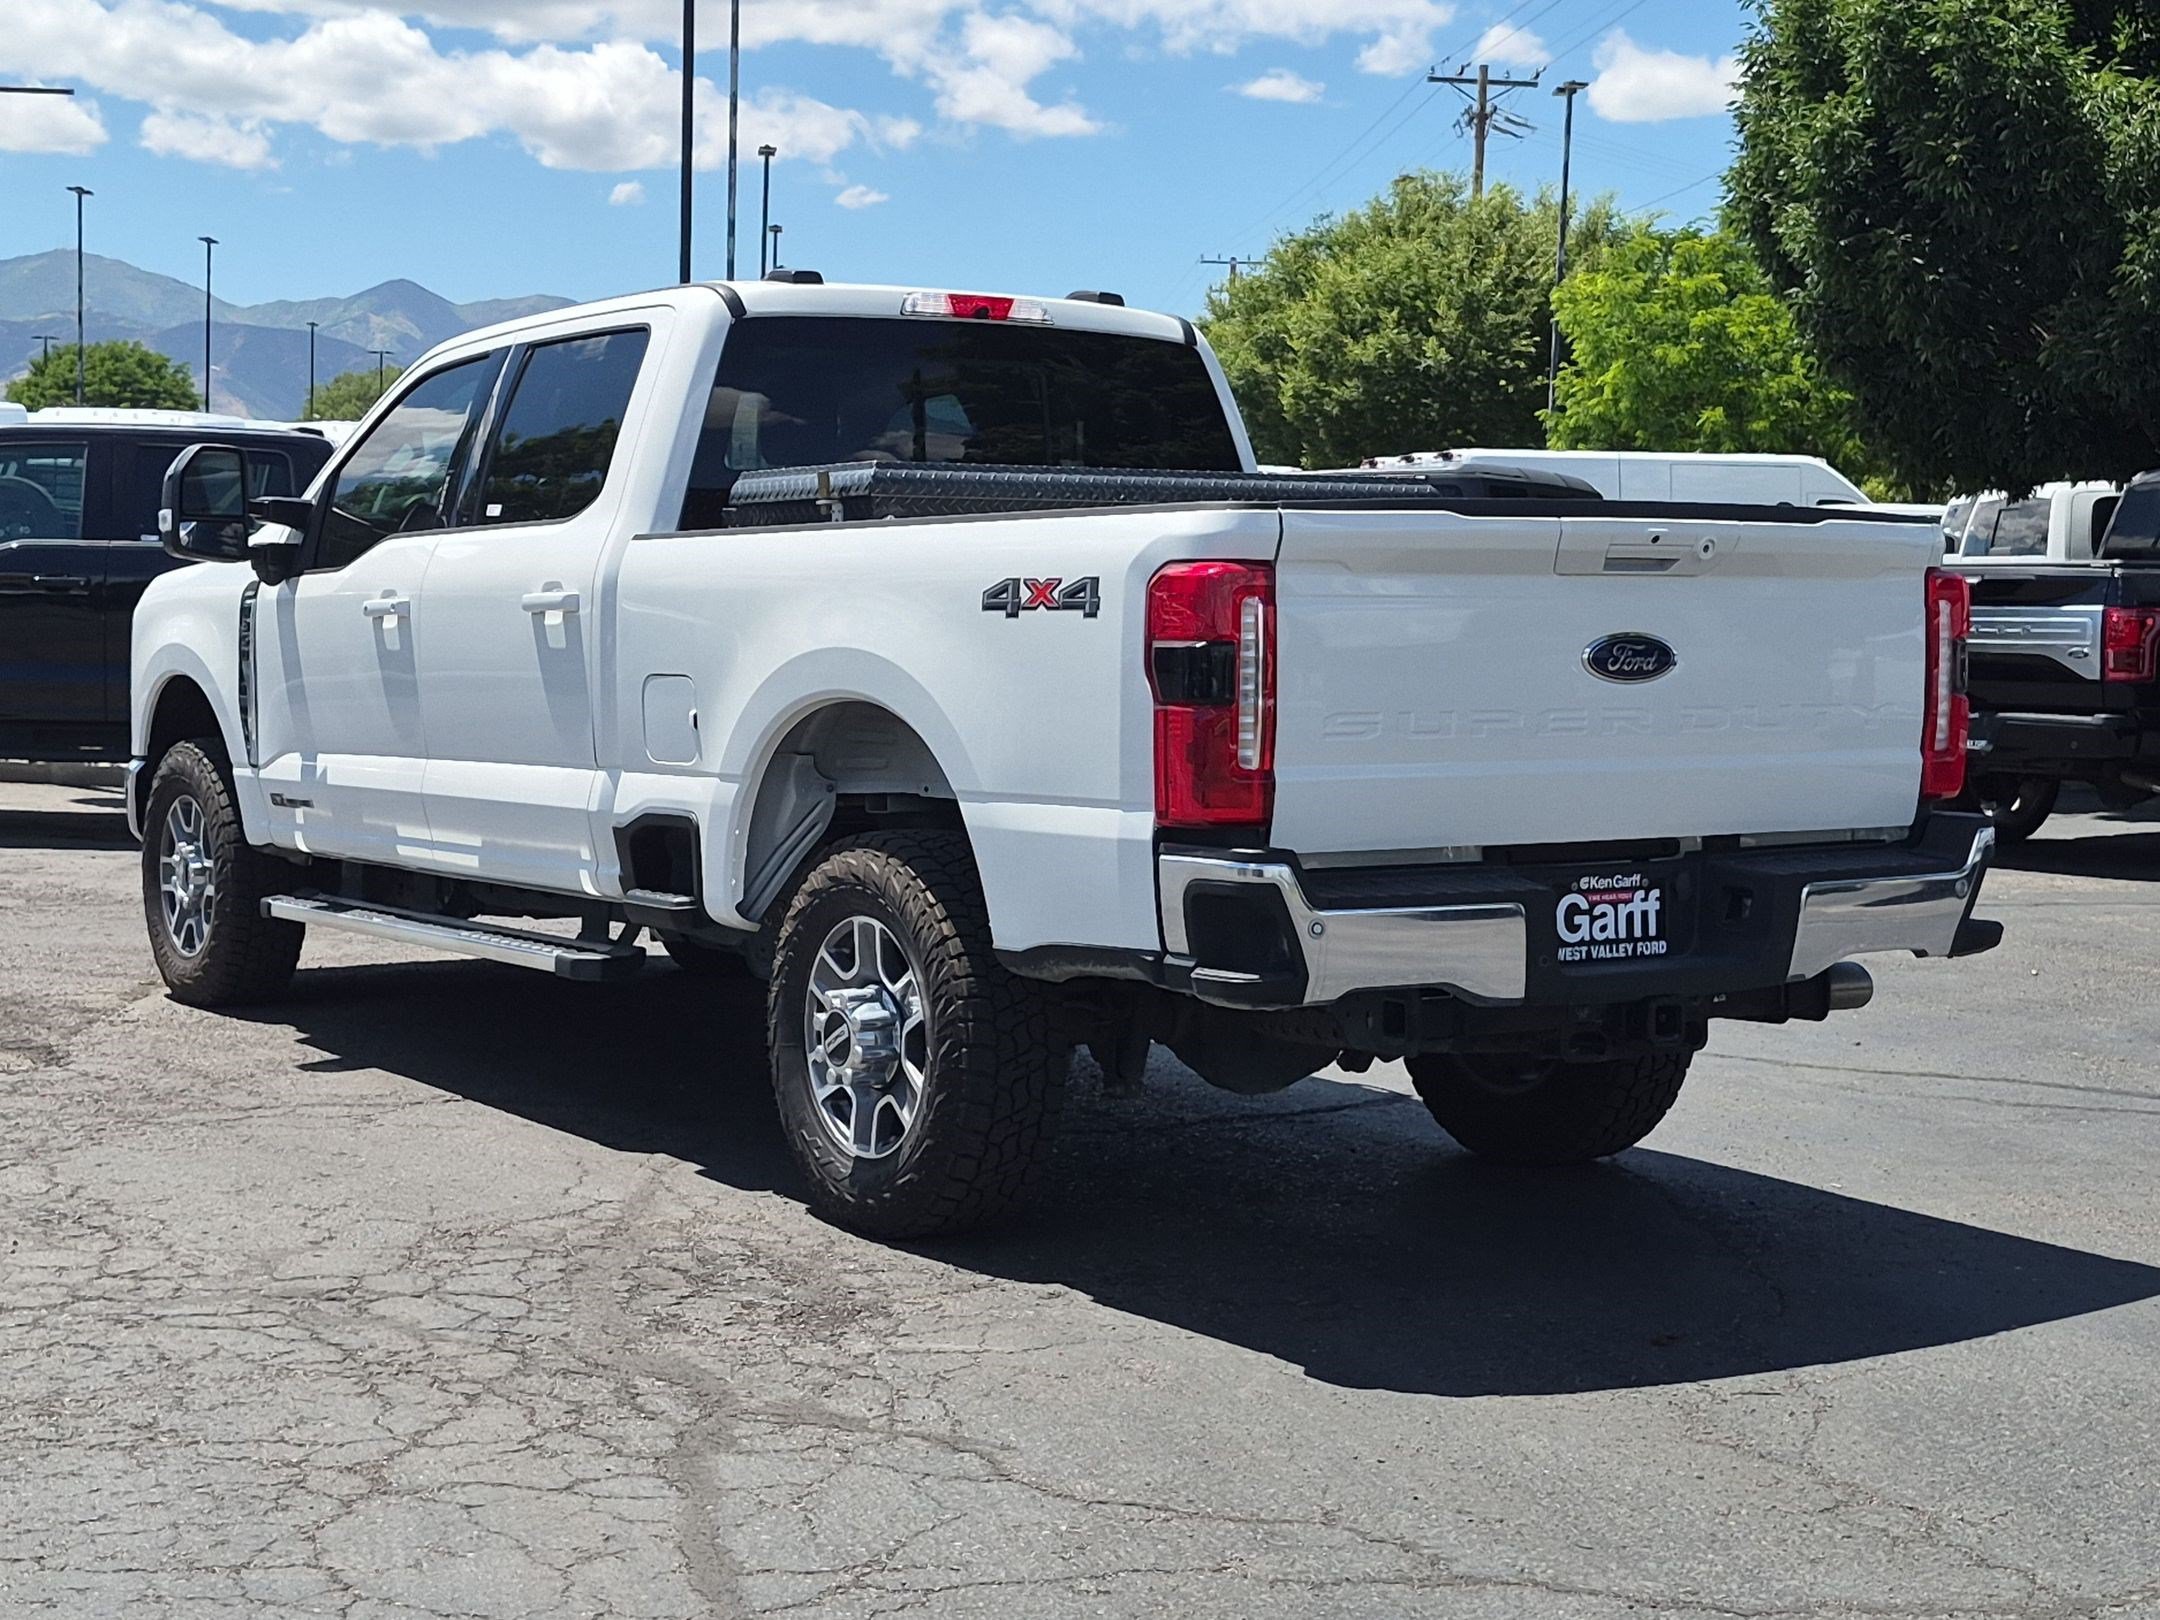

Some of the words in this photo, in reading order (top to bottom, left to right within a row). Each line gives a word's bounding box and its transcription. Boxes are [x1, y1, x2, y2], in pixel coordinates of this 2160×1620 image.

[1607, 643, 1659, 671] Ford
[1321, 705, 1653, 741] SUPER
[1556, 888, 1661, 944] Garff
[1590, 942, 1635, 959] VALLEY
[1637, 940, 1668, 957] FORD
